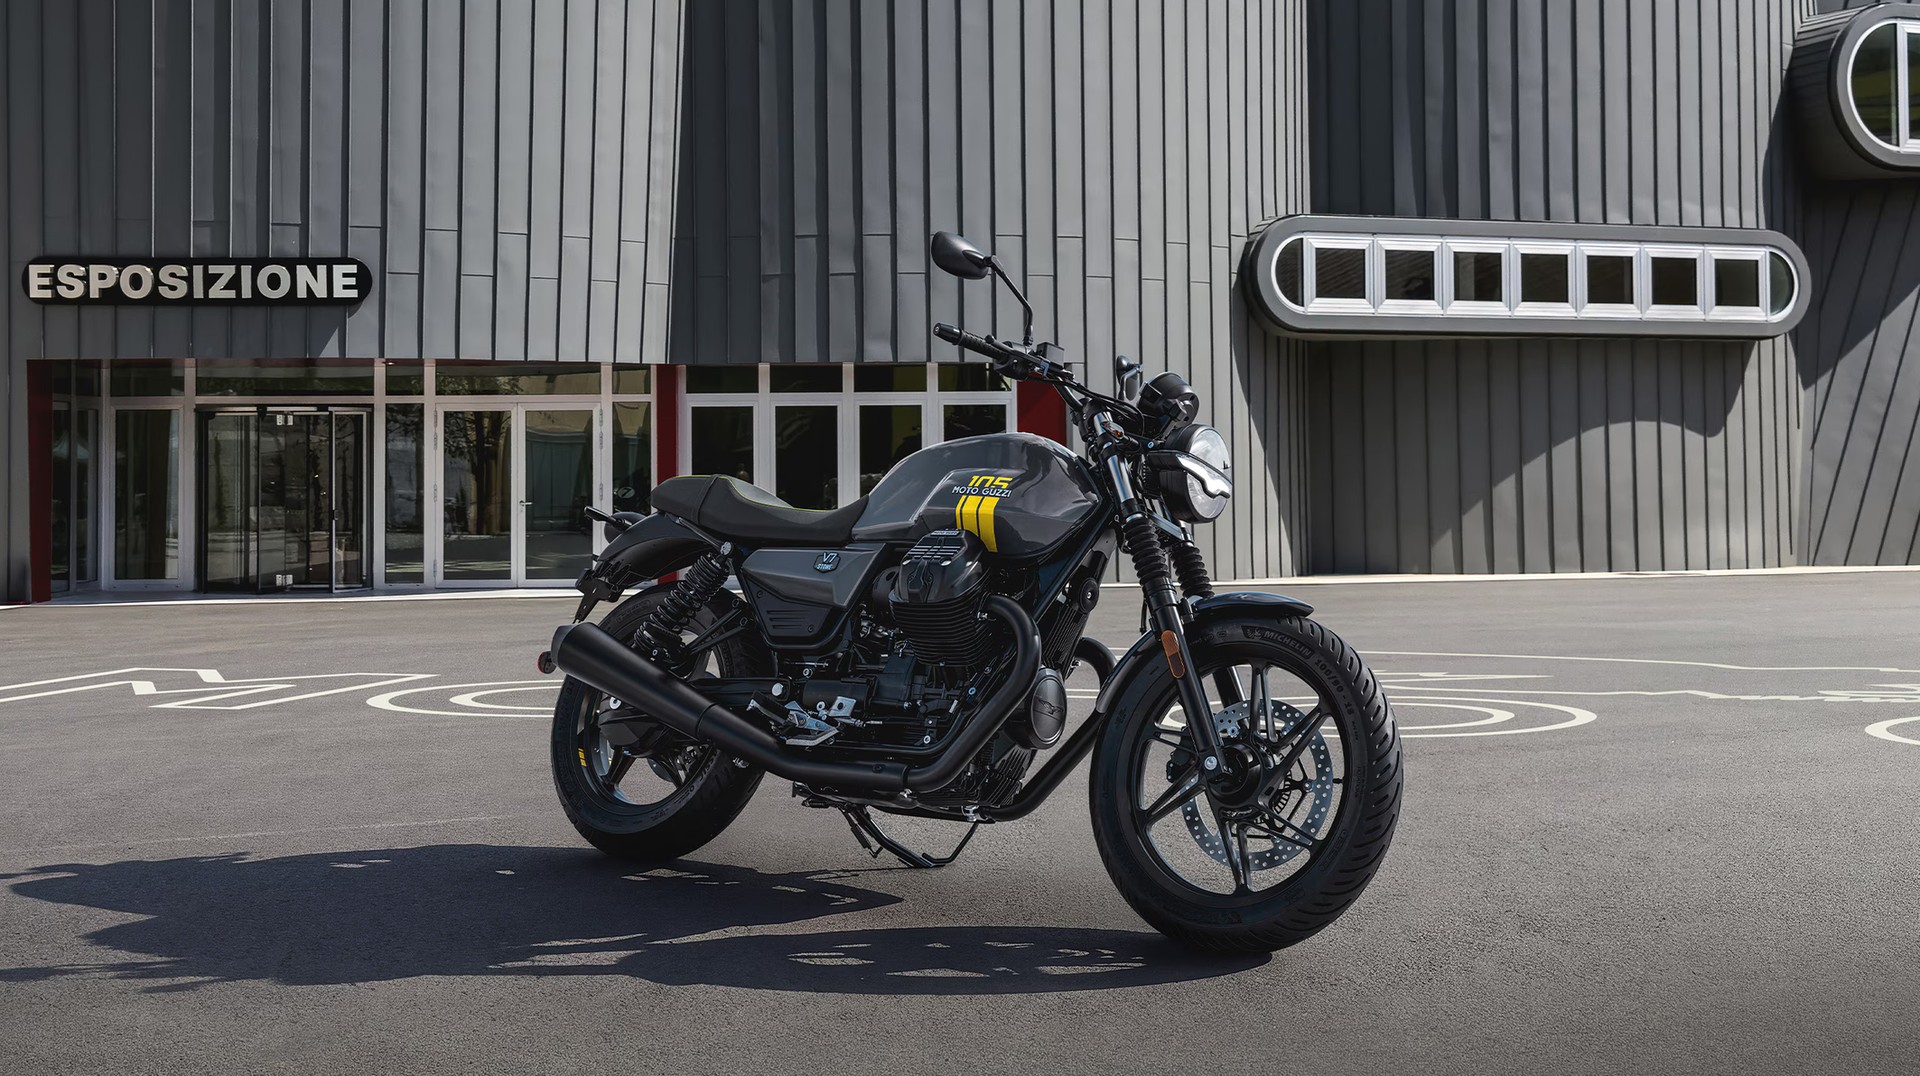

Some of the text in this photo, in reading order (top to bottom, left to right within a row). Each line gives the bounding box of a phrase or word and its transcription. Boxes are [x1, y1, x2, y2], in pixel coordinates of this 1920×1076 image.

[28, 264, 358, 299] ESPOSIZIONE
[968, 475, 1013, 489] 105
[952, 486, 1012, 497] MOTO GUZZI
[823, 552, 837, 562] V7
[1264, 630, 1311, 656] MICHELIN
